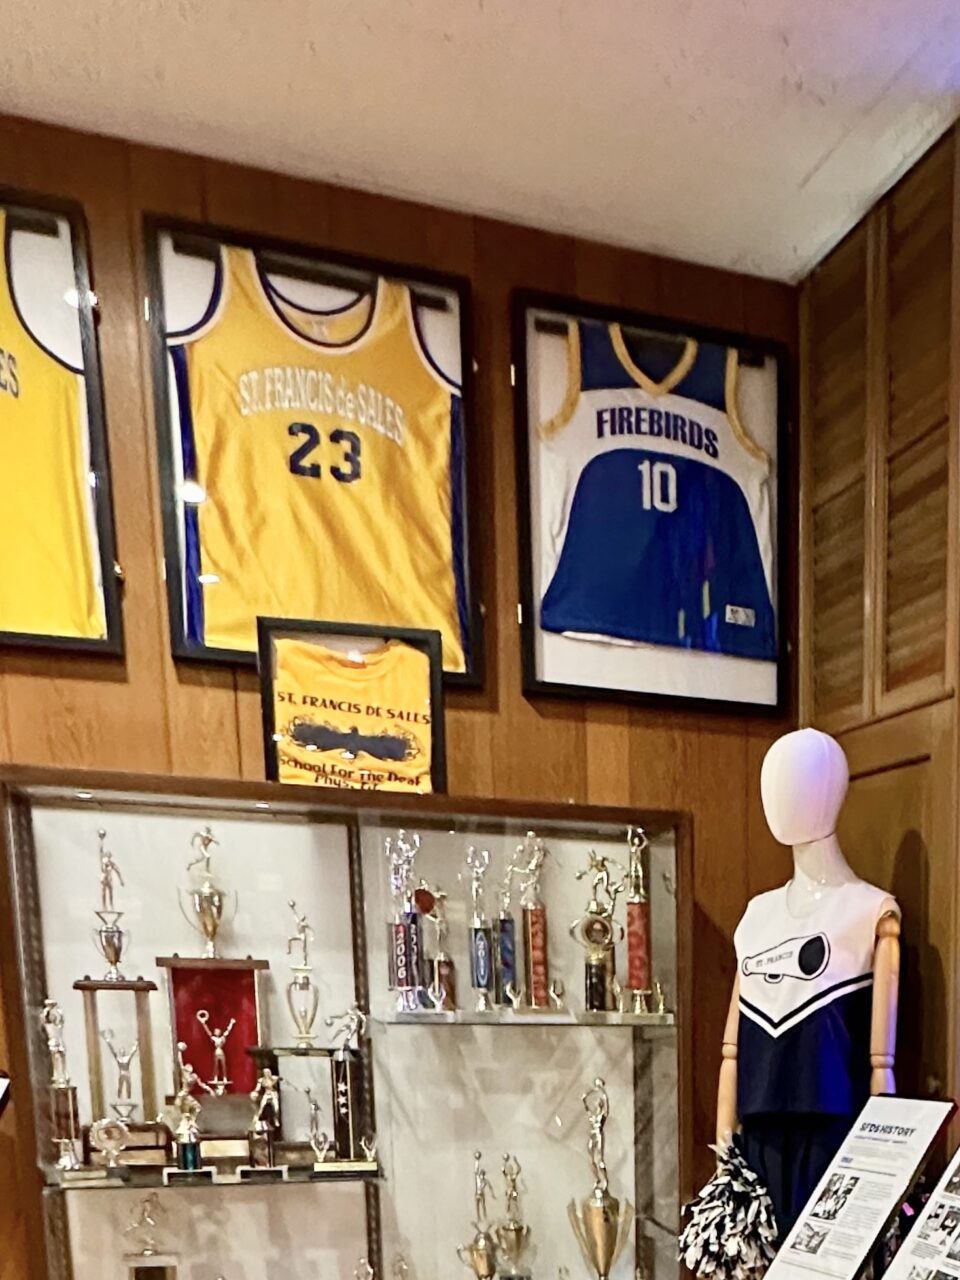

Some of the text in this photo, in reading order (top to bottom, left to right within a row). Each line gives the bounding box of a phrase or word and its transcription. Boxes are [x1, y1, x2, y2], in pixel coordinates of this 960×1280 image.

[263, 367, 333, 414] FRANCIS
[336, 375, 355, 420] de
[357, 383, 404, 446] SALES
[288, 422, 361, 483] 23
[596, 406, 719, 458] FIREBIRDS
[637, 459, 678, 513] 10
[277, 691, 431, 724] ST. FRANCIS DE SALES
[280, 756, 421, 786] School For The Deaf
[396, 933, 407, 979] 2006
[880, 1124, 917, 1137] HISTORY
